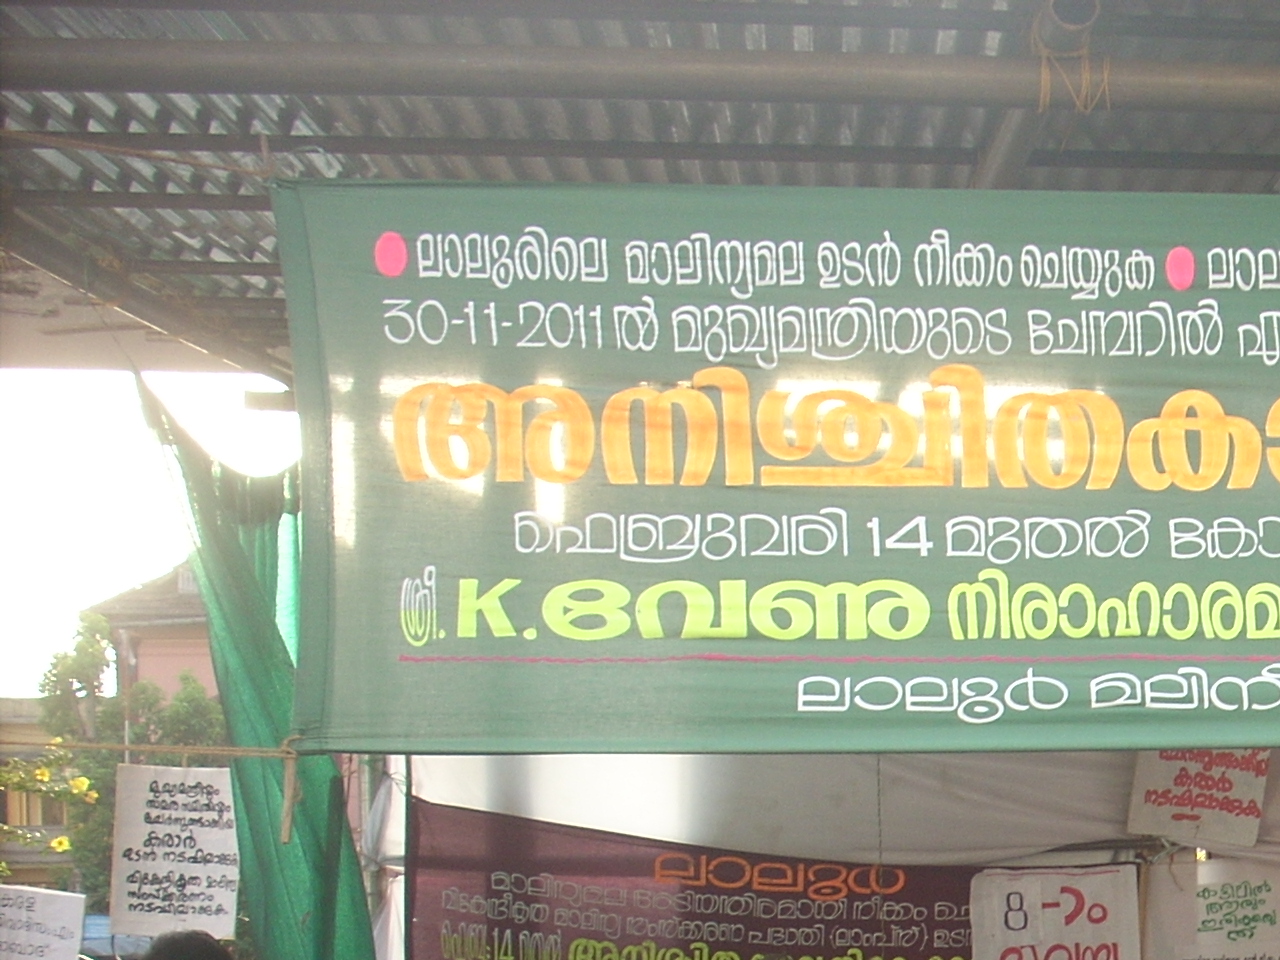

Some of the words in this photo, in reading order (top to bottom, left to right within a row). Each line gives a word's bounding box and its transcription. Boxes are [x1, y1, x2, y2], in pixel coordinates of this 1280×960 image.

[417, 226, 608, 289] ലാലൂരിലെ
[625, 233, 802, 299] മാലിന്യമല
[818, 231, 901, 289] ഉടൻ
[914, 229, 1012, 287] നീക്കം
[1020, 245, 1155, 300] ചെയ്യുക
[673, 297, 1012, 370] മുഖ്യമന്ത്രിയുടെ
[513, 507, 849, 564] ഫെബ്രുവരി
[866, 516, 934, 558] 14
[944, 507, 1152, 564] മുതൽ
[797, 667, 1069, 724] ലാലൂർ
